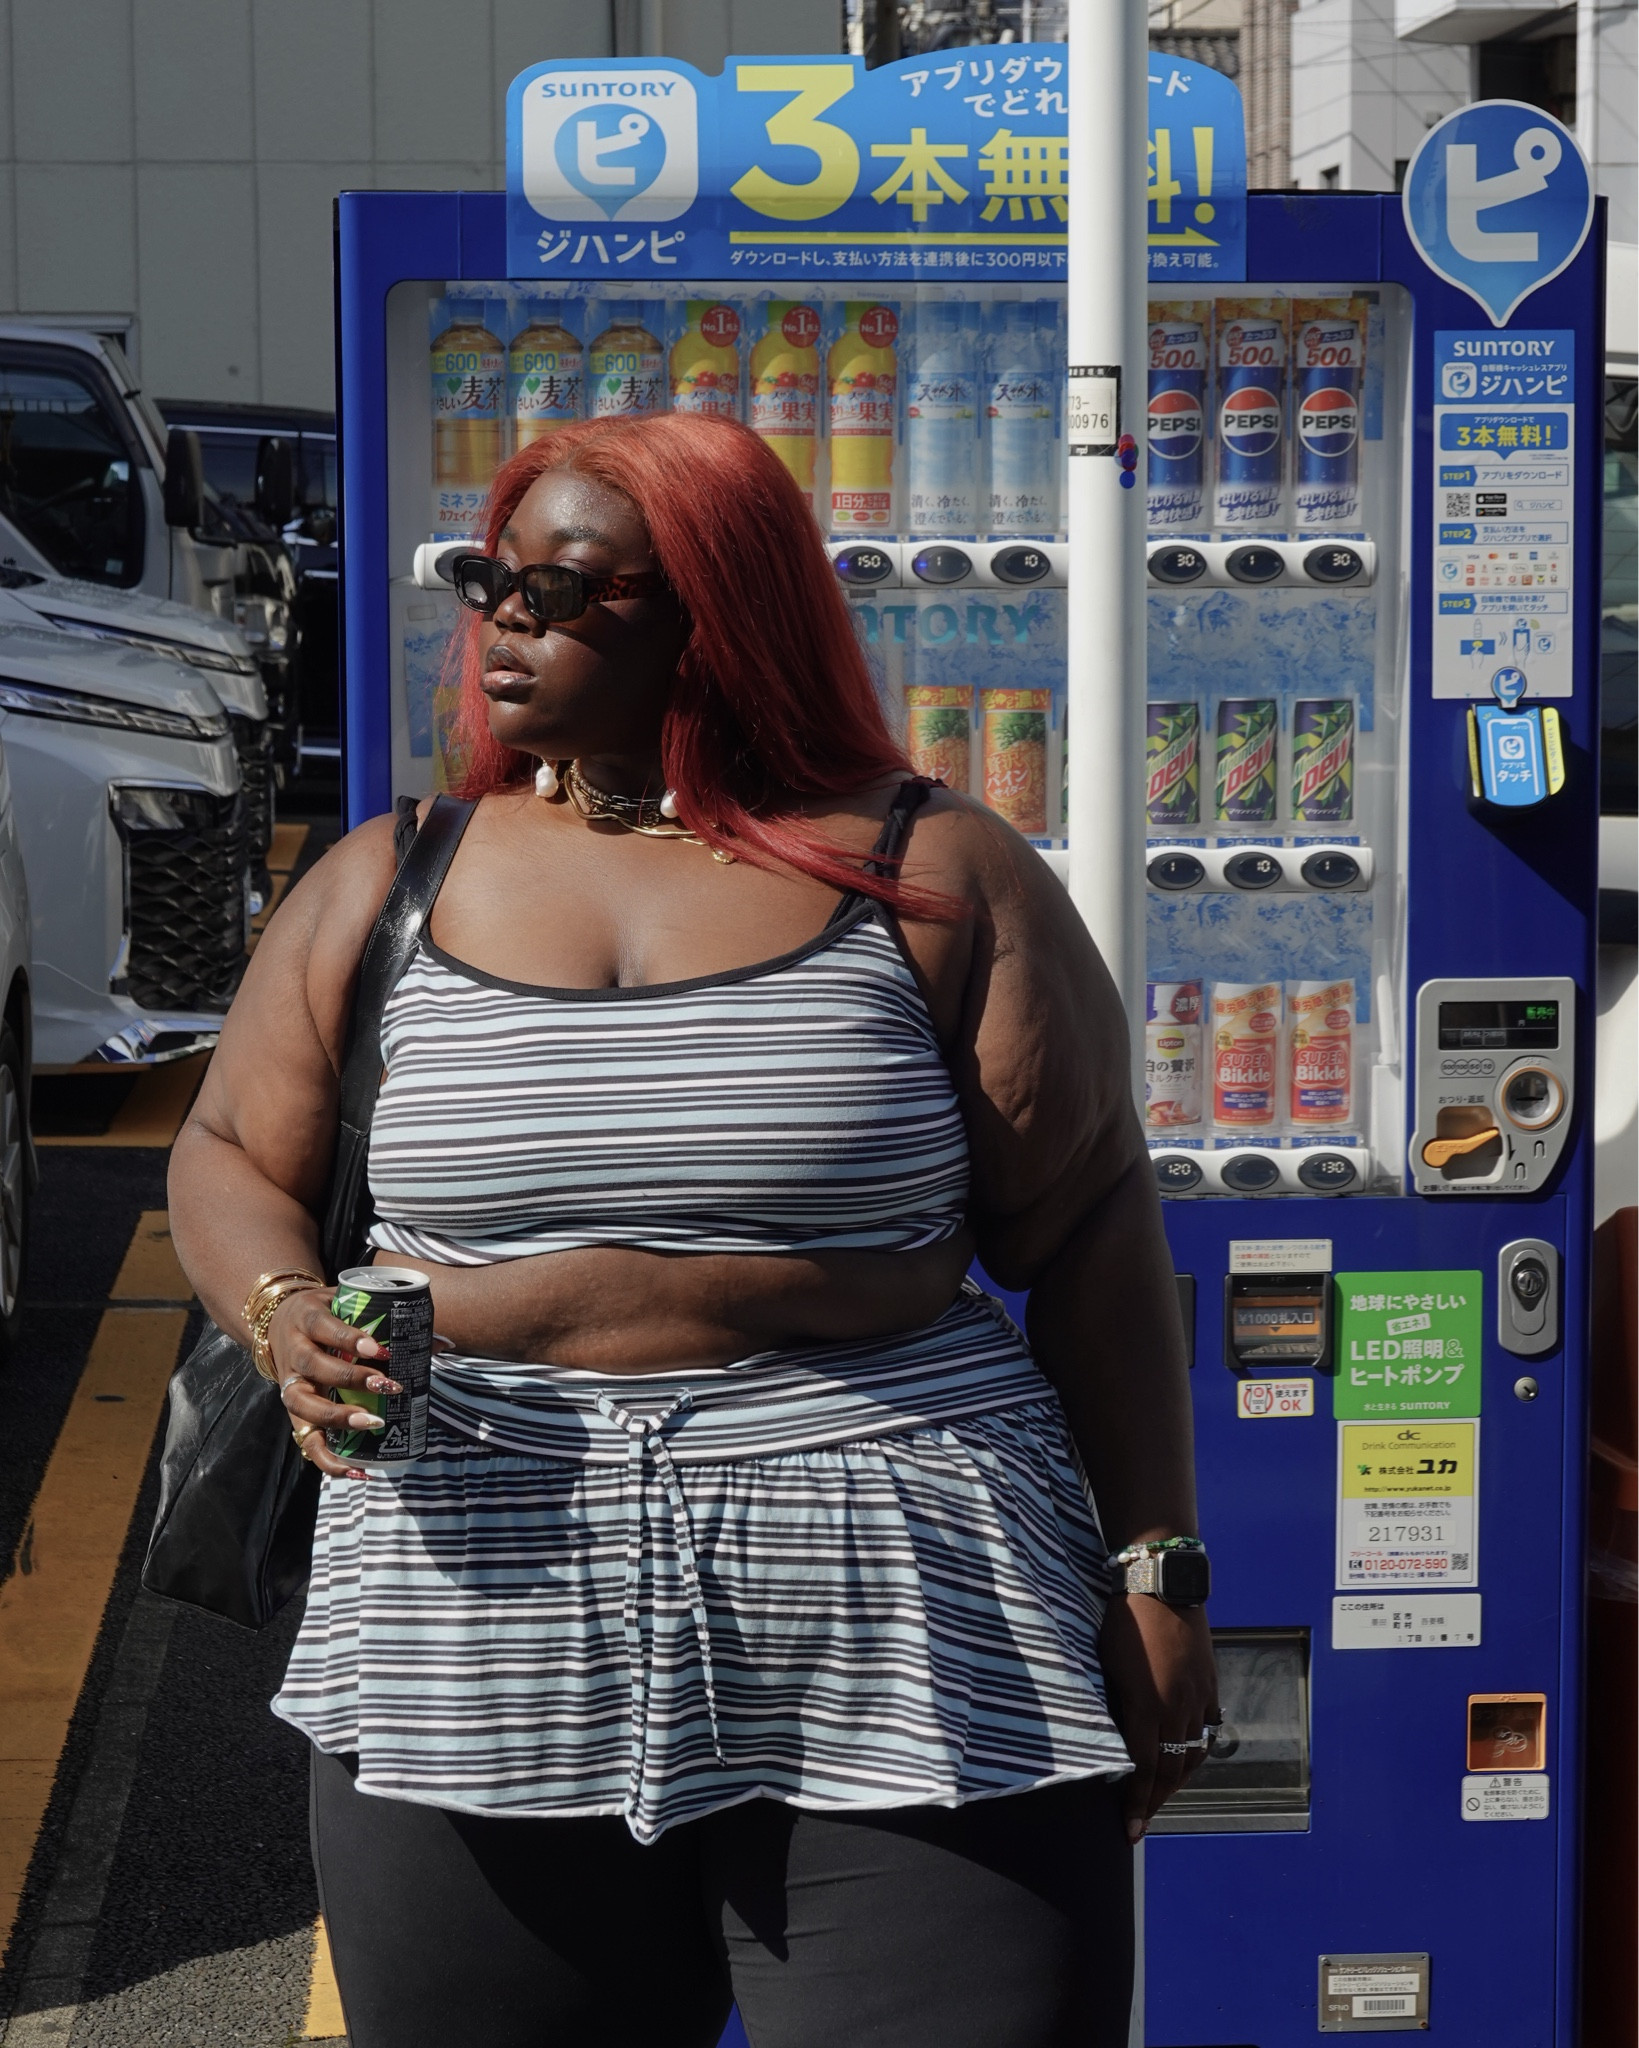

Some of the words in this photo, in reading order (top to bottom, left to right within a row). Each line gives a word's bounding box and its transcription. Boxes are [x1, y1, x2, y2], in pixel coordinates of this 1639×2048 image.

[541, 82, 676, 98] SUNTORY
[963, 88, 1068, 118] でどれ
[577, 113, 650, 185] ピ
[1446, 127, 1562, 263] ピ
[537, 230, 686, 264] ジハンピ
[1229, 347, 1273, 365] 500
[1453, 340, 1554, 356] SUNTORY
[446, 353, 477, 371] 600
[524, 353, 556, 371] 600
[605, 353, 637, 372] 600
[1151, 350, 1195, 368] 500
[1307, 348, 1351, 366] 500
[1481, 375, 1567, 395] ジハンピ
[1148, 418, 1200, 431] PEPSI
[1224, 415, 1279, 429] PEPSI
[1303, 416, 1356, 429] PEPSI
[1457, 425, 1551, 447] 3本無料!
[1482, 471, 1562, 480] アプリをダウンロード
[1499, 672, 1520, 695] ピ
[986, 769, 1028, 789] パイン
[1497, 770, 1532, 782] タッチ
[1159, 1039, 1184, 1049] Lipton
[1223, 1052, 1268, 1068] SUPER
[1299, 1050, 1344, 1066] SUPER
[1219, 1067, 1271, 1083] Bikkle
[1296, 1065, 1346, 1081] Bikkle
[1350, 1294, 1466, 1311] 地球にやさしい
[1351, 1339, 1464, 1360] LED照明&
[1351, 1364, 1464, 1386] ヒートポンプ
[1280, 1399, 1302, 1411] OK
[1364, 1403, 1397, 1411] 水と生きる
[1400, 1402, 1450, 1410] SUNTORY
[1362, 1442, 1385, 1450] Drink
[1388, 1441, 1456, 1450] Communication
[1369, 1526, 1445, 1542] 217931
[1364, 1559, 1448, 1570] 0120-072-590
